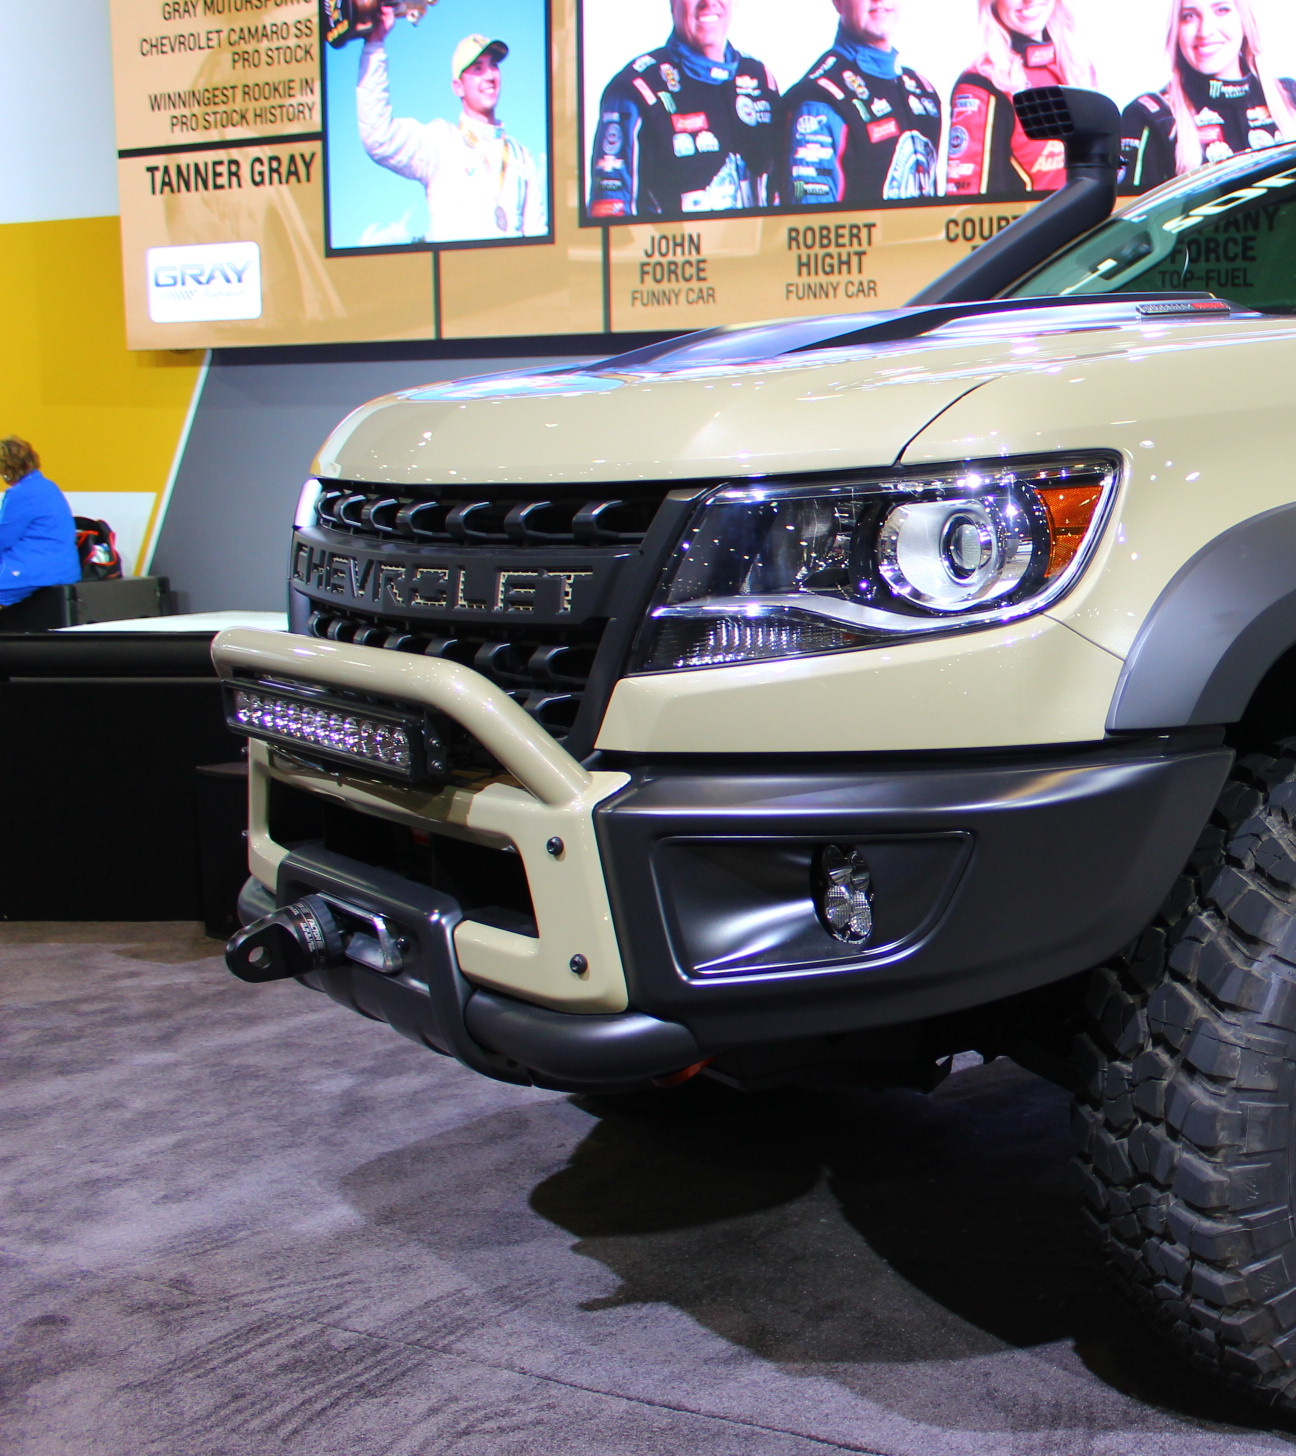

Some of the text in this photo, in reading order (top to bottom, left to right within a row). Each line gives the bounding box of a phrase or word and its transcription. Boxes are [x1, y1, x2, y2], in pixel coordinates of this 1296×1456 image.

[162, 1, 199, 21] GRAY
[140, 29, 224, 57] CHEVROLET
[228, 22, 290, 47] CAMARO
[293, 19, 313, 39] SS
[232, 44, 314, 70] PRO STOCK
[149, 77, 315, 112] WINNINGEST ROOKIE IN
[170, 101, 315, 134] PRO STOCK HISTORY
[145, 152, 316, 196] TANNER GRAY
[643, 232, 702, 259] JOHN
[786, 222, 877, 251] ROBERT
[153, 260, 254, 288] GRAY
[639, 259, 708, 285] FORCE
[796, 251, 867, 277] HIGHT
[631, 286, 716, 307] FUNNY CAR
[785, 279, 878, 302] FUNNY CAR
[294, 540, 594, 616] CHEVROLET
